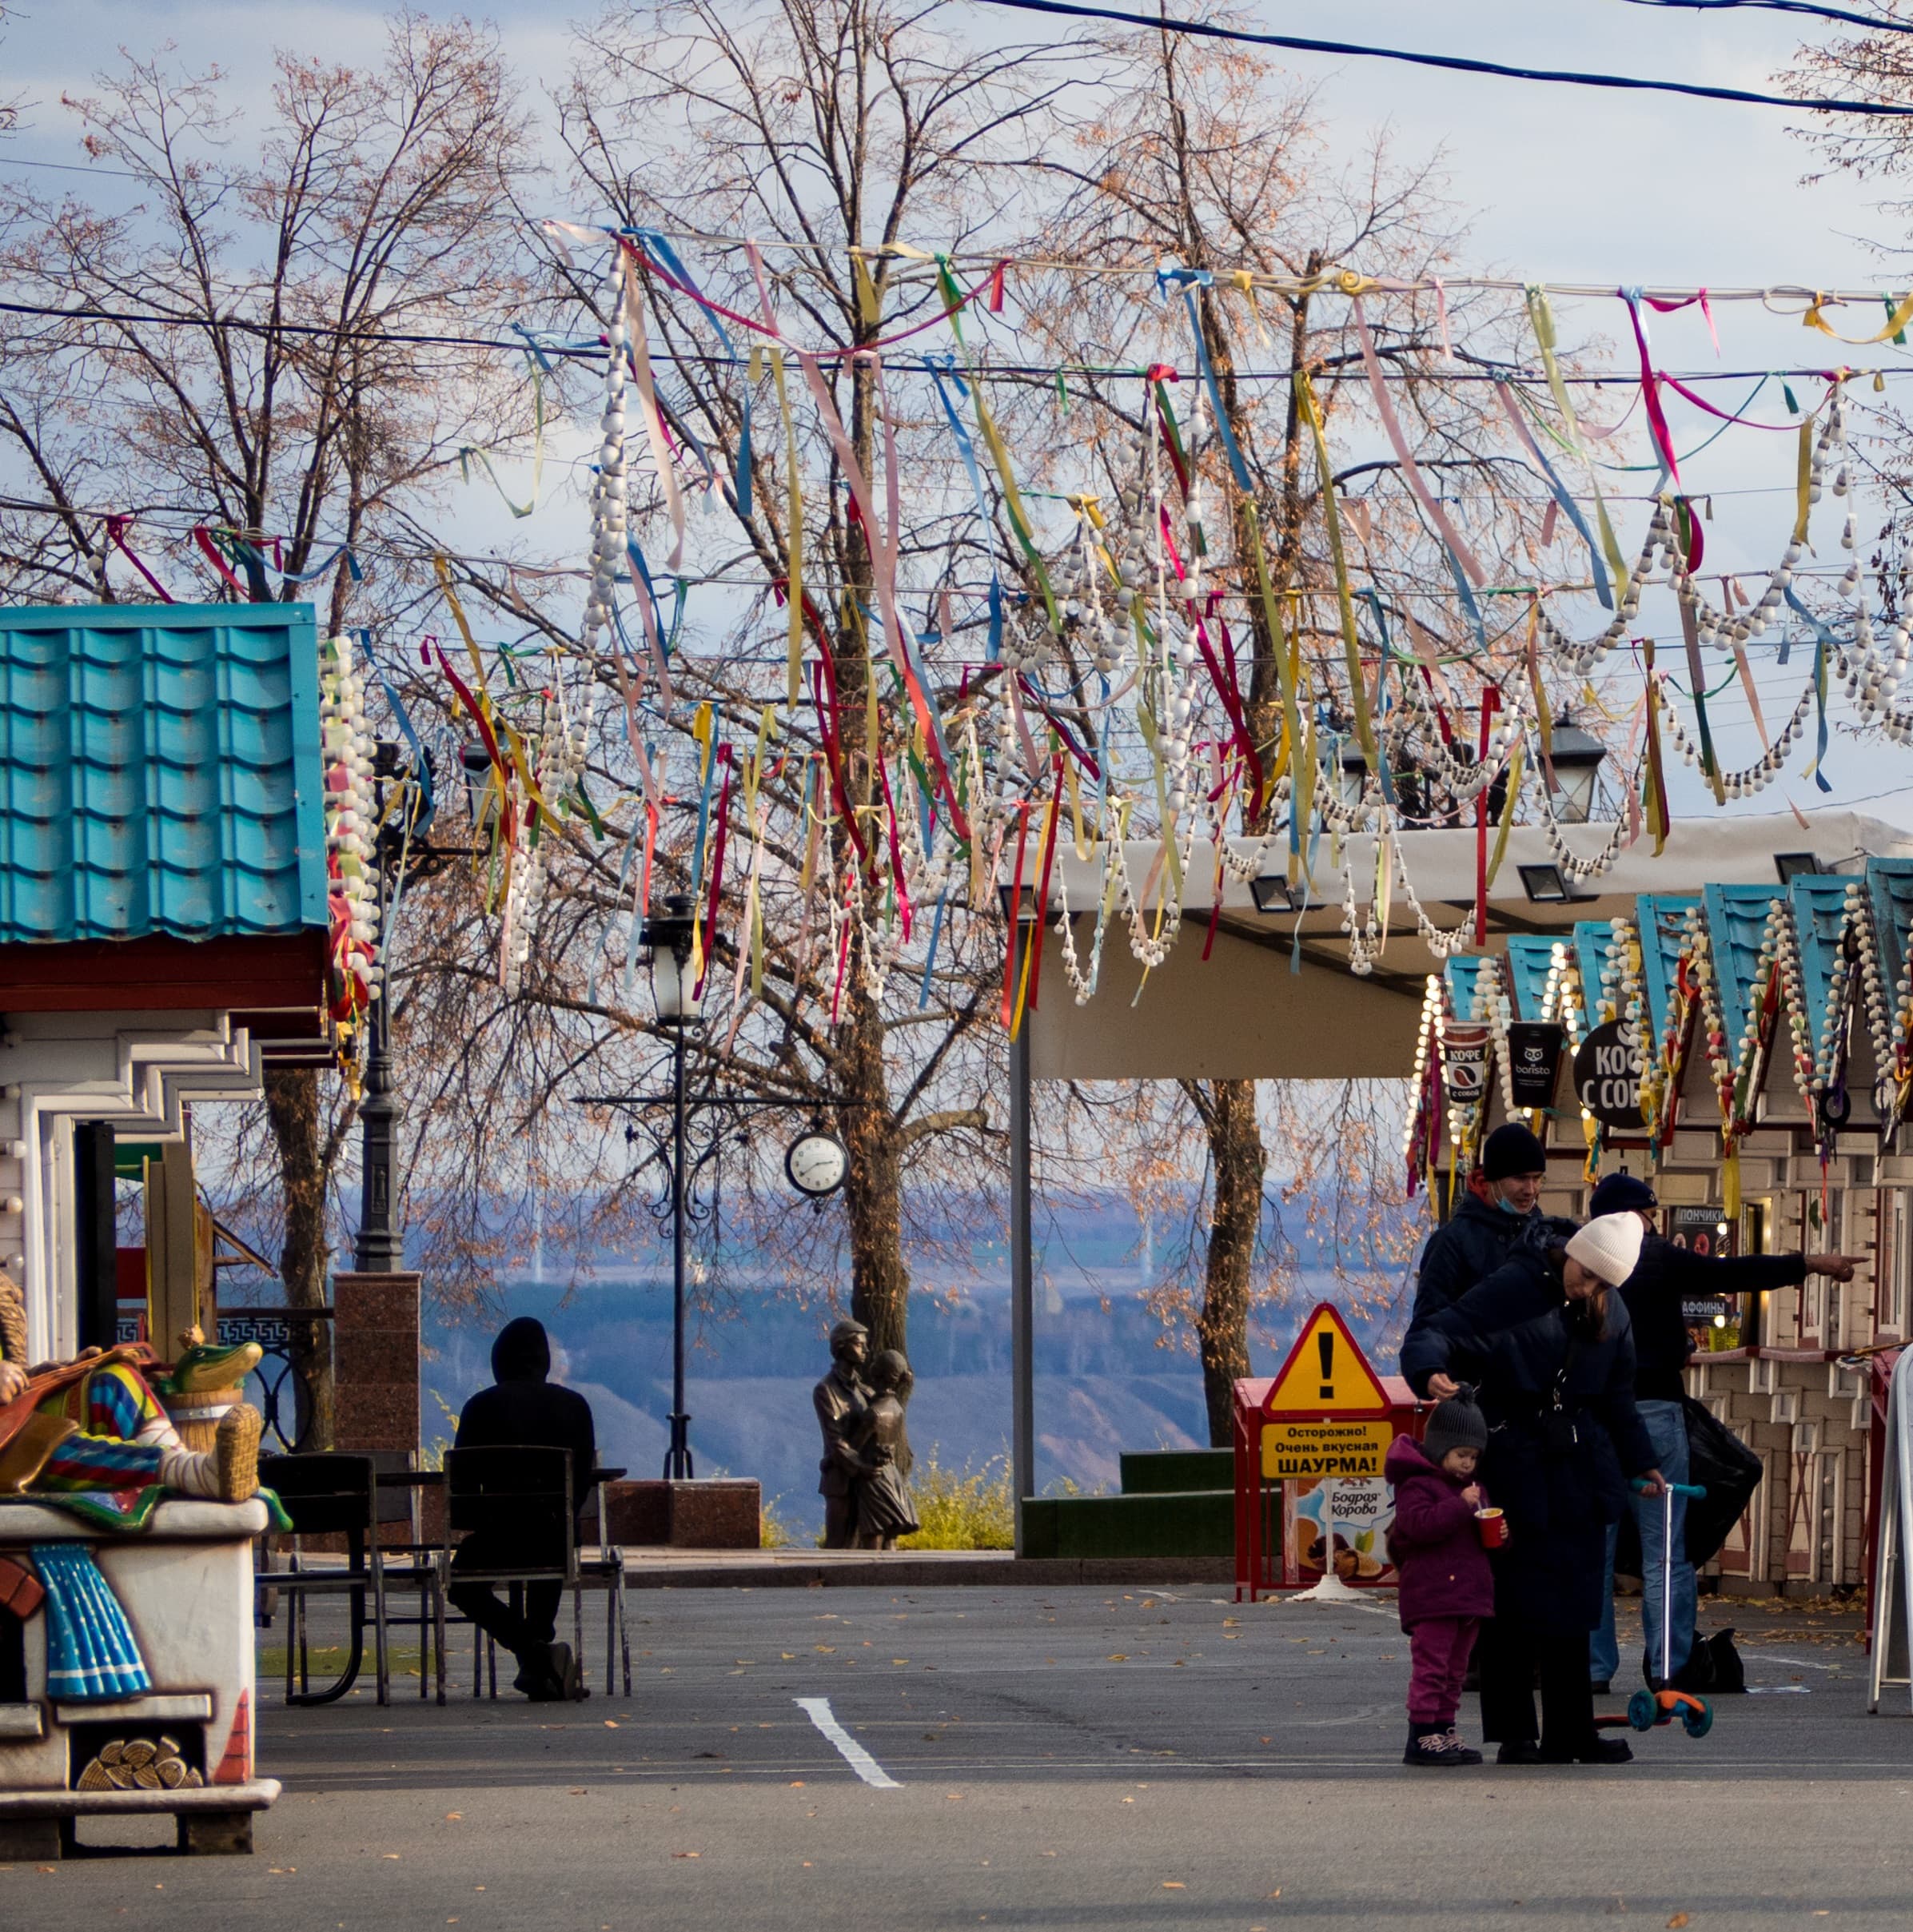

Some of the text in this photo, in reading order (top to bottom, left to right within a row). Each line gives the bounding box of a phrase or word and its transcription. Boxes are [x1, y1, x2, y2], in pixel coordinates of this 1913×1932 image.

[1449, 1049, 1481, 1062] КОФЕ
[1596, 1046, 1639, 1074] КО
[1515, 1064, 1551, 1074] barista
[1582, 1078, 1641, 1109] С СОБ
[1680, 1209, 1725, 1222] ПОНЧИКИ
[1682, 1301, 1725, 1314] АФФИНЫ
[1288, 1426, 1367, 1439] Осторожно!
[1275, 1442, 1378, 1454] Очень вкусная
[1278, 1457, 1377, 1473] ШАУРМА!
[1332, 1492, 1377, 1506] Бодрая
[1332, 1503, 1377, 1518] Корова
